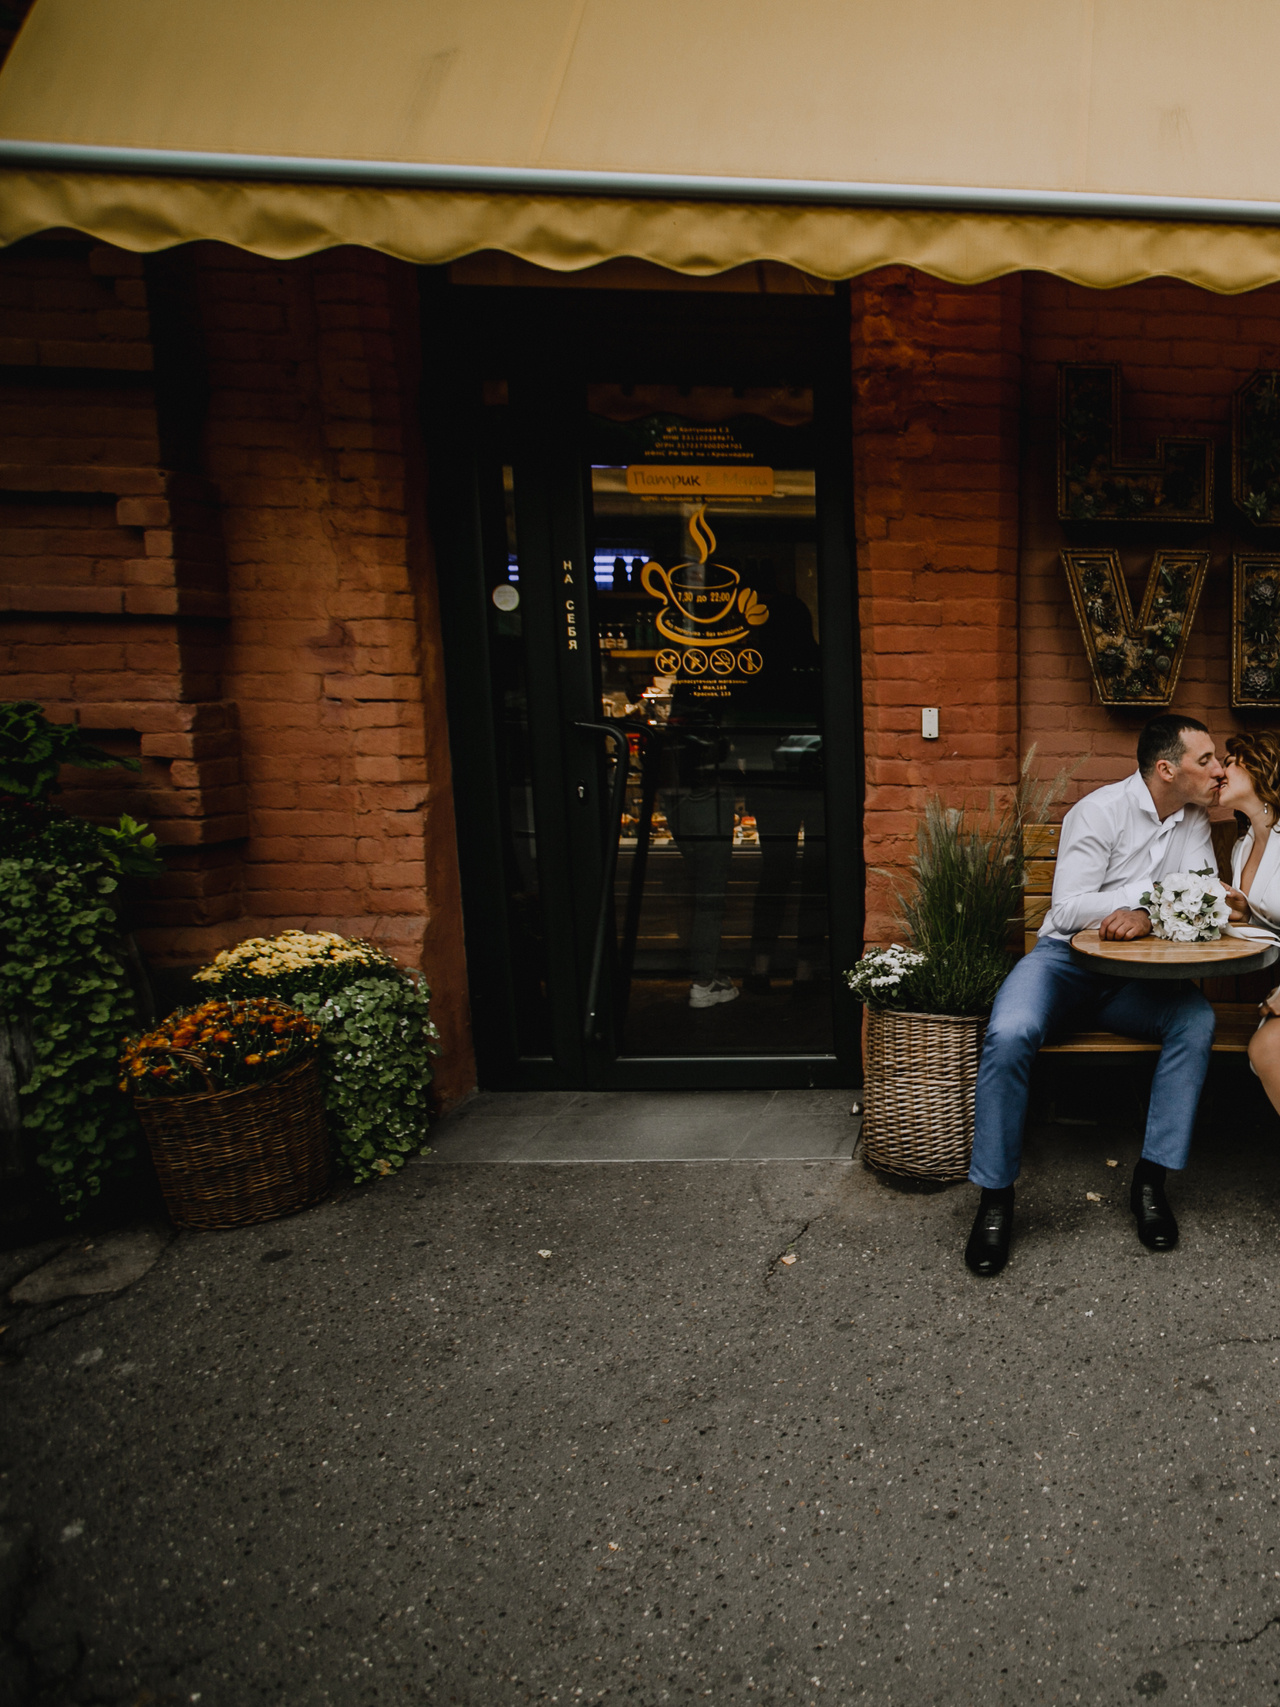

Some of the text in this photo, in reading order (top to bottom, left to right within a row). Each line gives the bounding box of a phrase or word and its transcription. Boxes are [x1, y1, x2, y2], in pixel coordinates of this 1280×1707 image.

[633, 471, 701, 489] Патрик
[562, 560, 578, 650] НА СЕБЯ
[696, 594, 707, 603] до
[710, 591, 730, 603] 22:00
